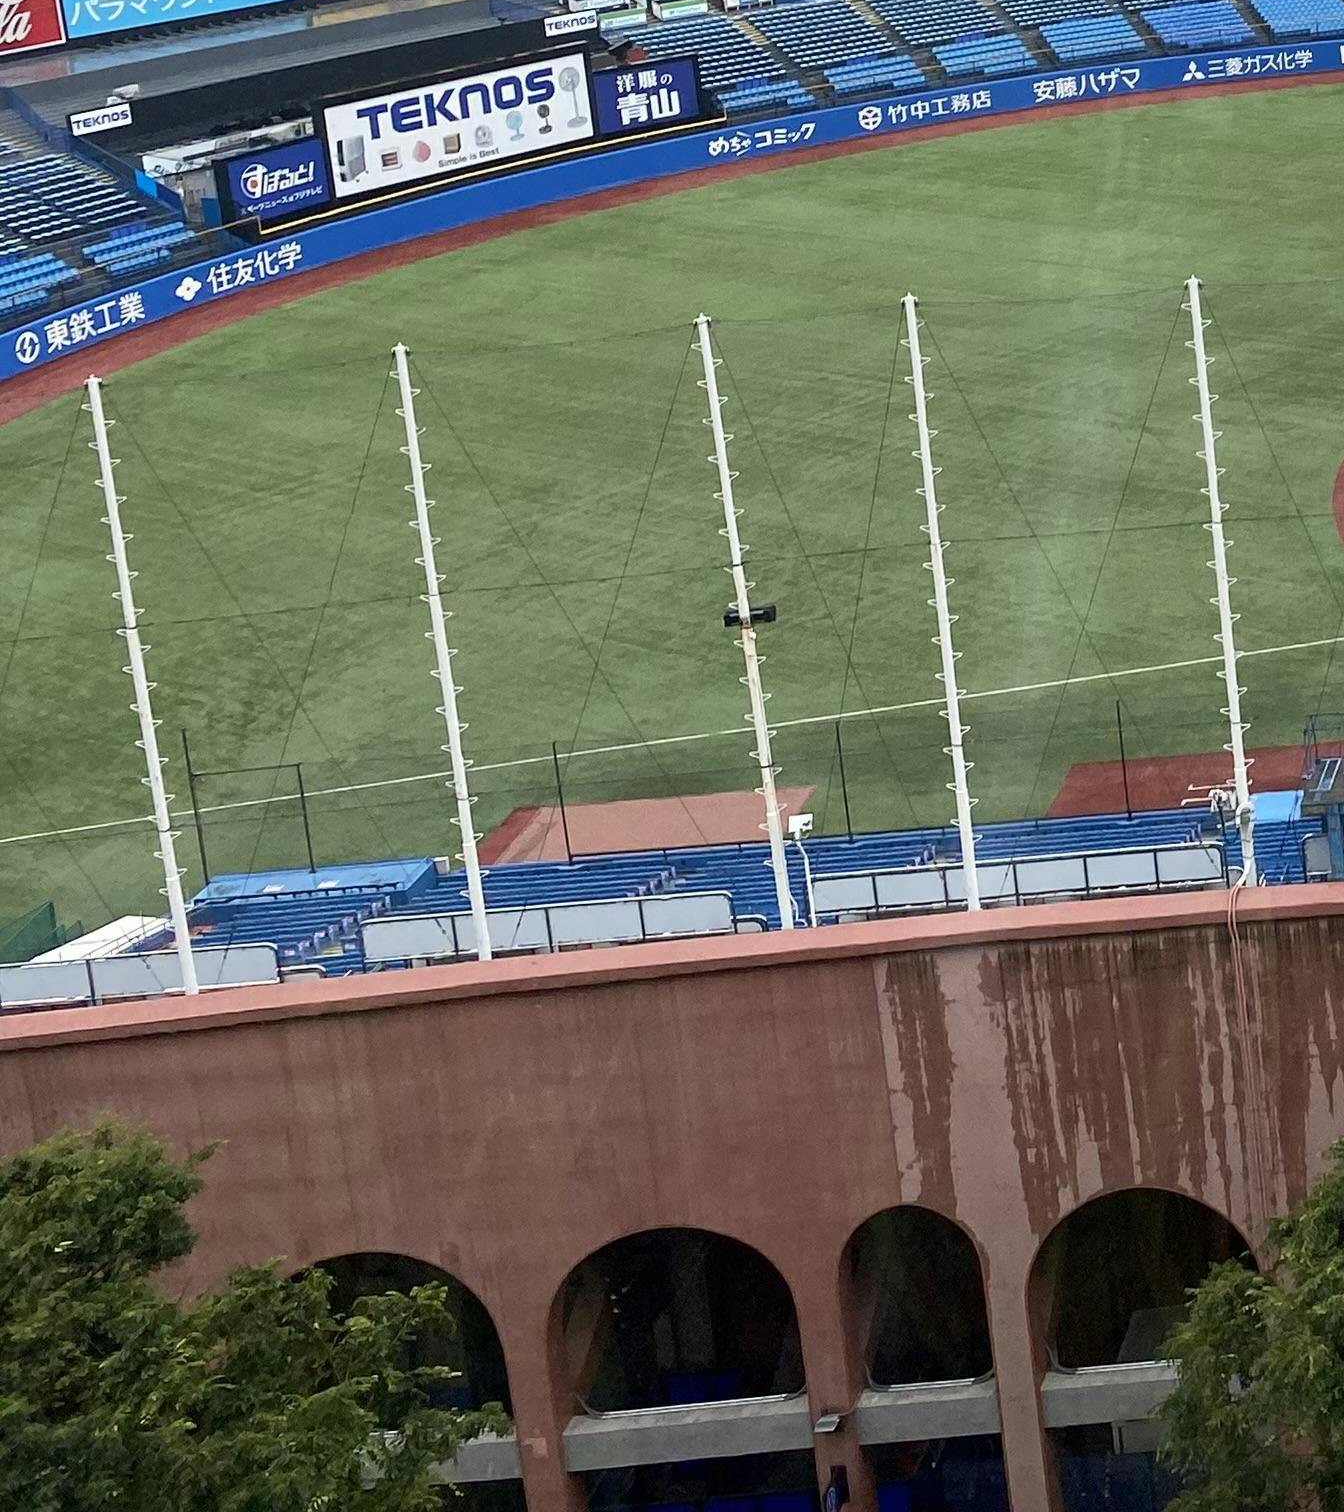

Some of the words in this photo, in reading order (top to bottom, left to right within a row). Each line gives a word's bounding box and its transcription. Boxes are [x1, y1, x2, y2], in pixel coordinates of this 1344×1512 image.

[546, 14, 596, 32] TEKNOS
[1207, 49, 1313, 79] 三菱ガス化学
[616, 70, 673, 93] 洋服の
[1033, 68, 1141, 103] 安藤ハザマ
[356, 67, 555, 139] TEKNOS
[616, 87, 681, 126] 青山
[888, 90, 992, 124] 竹中工務店
[72, 109, 129, 131] TEKNOS
[479, 147, 500, 159] Best
[708, 123, 816, 156] めちゃコミック
[207, 241, 303, 294] 住友化学
[44, 291, 146, 354] 東鉄工業
